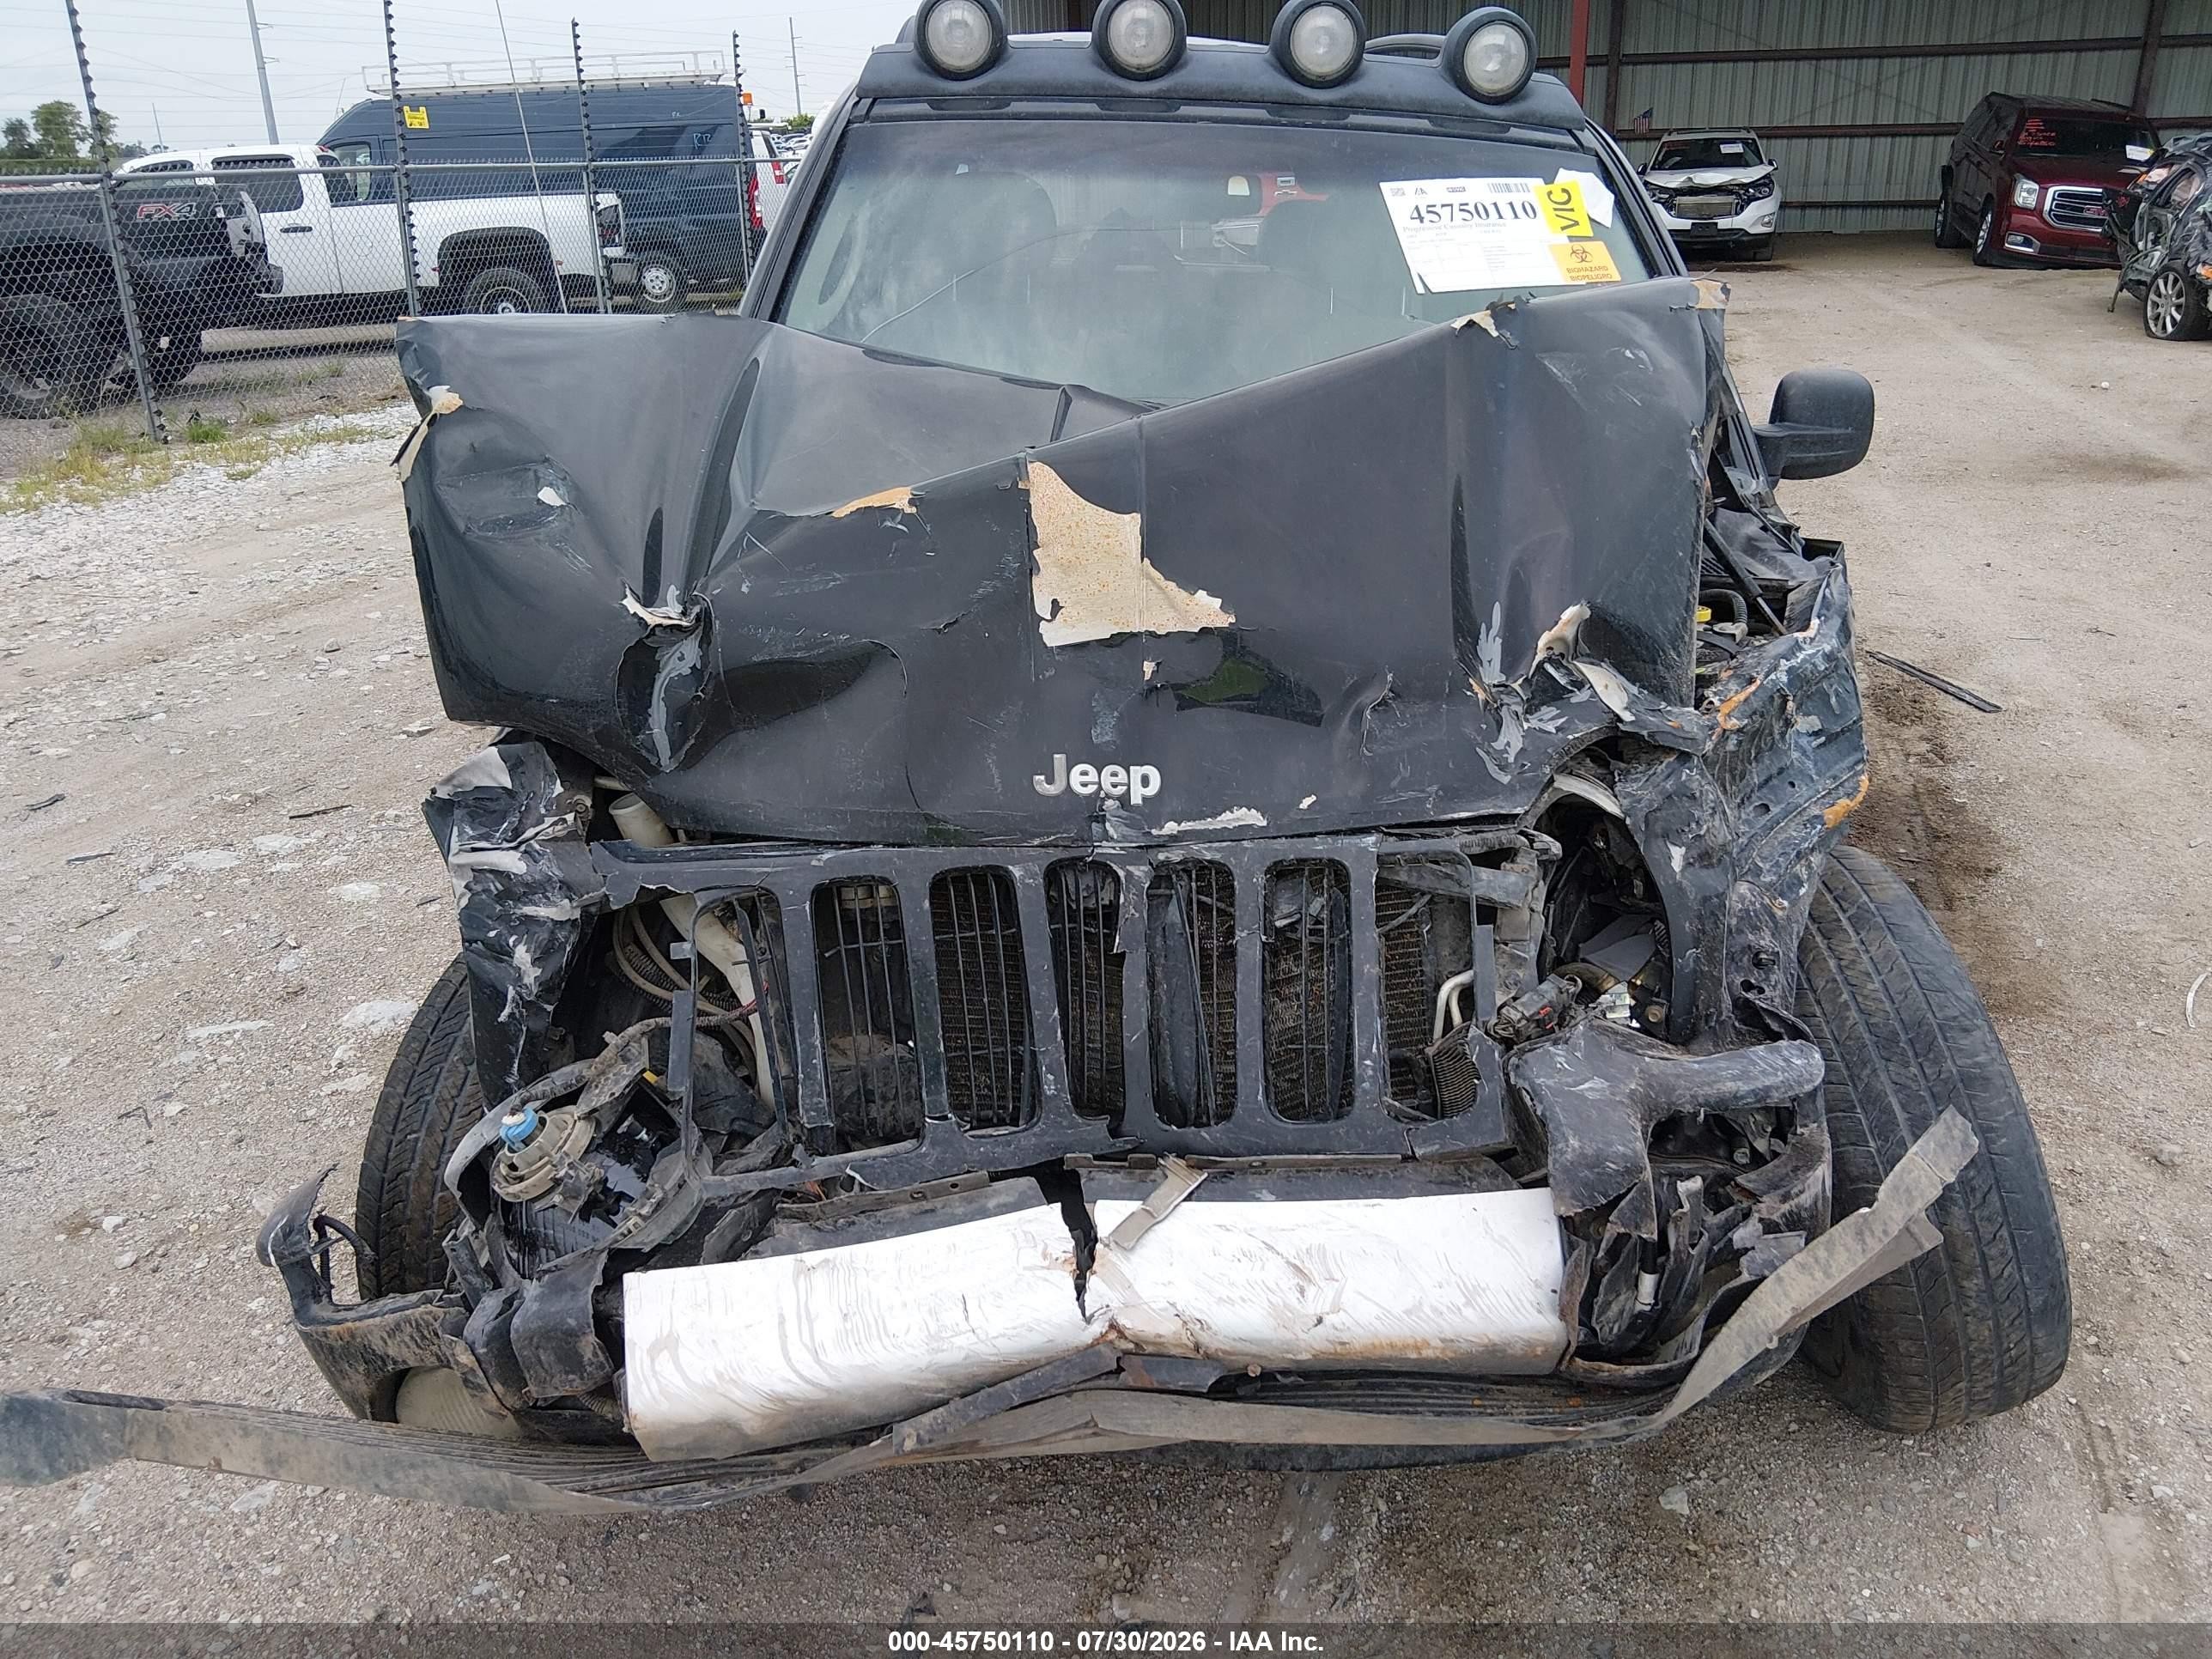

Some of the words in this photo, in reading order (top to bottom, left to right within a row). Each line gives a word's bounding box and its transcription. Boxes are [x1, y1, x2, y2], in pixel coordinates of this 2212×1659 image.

[137, 202, 196, 218] FX4
[1409, 200, 1538, 224] 45750110
[1547, 187, 1581, 232] VIC
[1566, 265, 1608, 274] BIOHAZARD
[1570, 273, 1613, 282] BIOPELIGRO
[1033, 753, 1162, 805] Jeep
